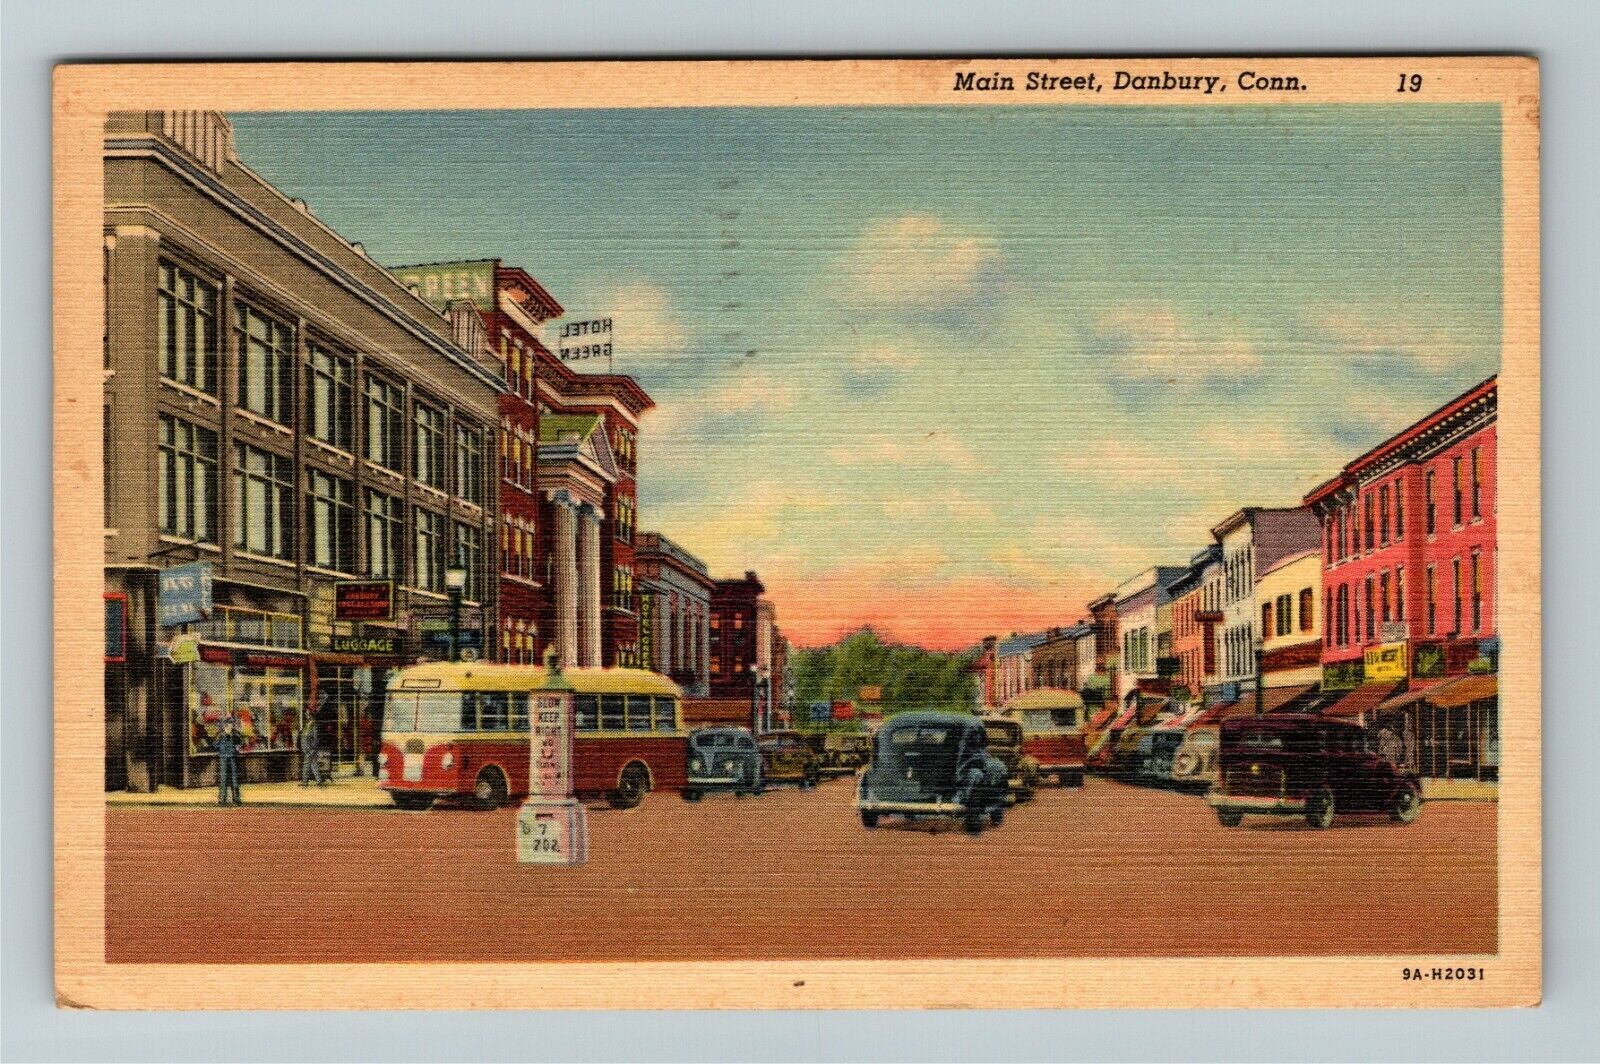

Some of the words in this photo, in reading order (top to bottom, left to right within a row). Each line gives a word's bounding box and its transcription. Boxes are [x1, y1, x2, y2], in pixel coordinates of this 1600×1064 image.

[953, 72, 1015, 91] Main
[1025, 72, 1103, 93] Street,
[1113, 71, 1227, 94] Danbury,
[1237, 71, 1307, 91] Conn.
[1396, 73, 1423, 93] 19
[334, 639, 394, 652] LUGGAGE
[538, 711, 560, 723] KEEP
[1402, 967, 1485, 981] 9A-H2031
